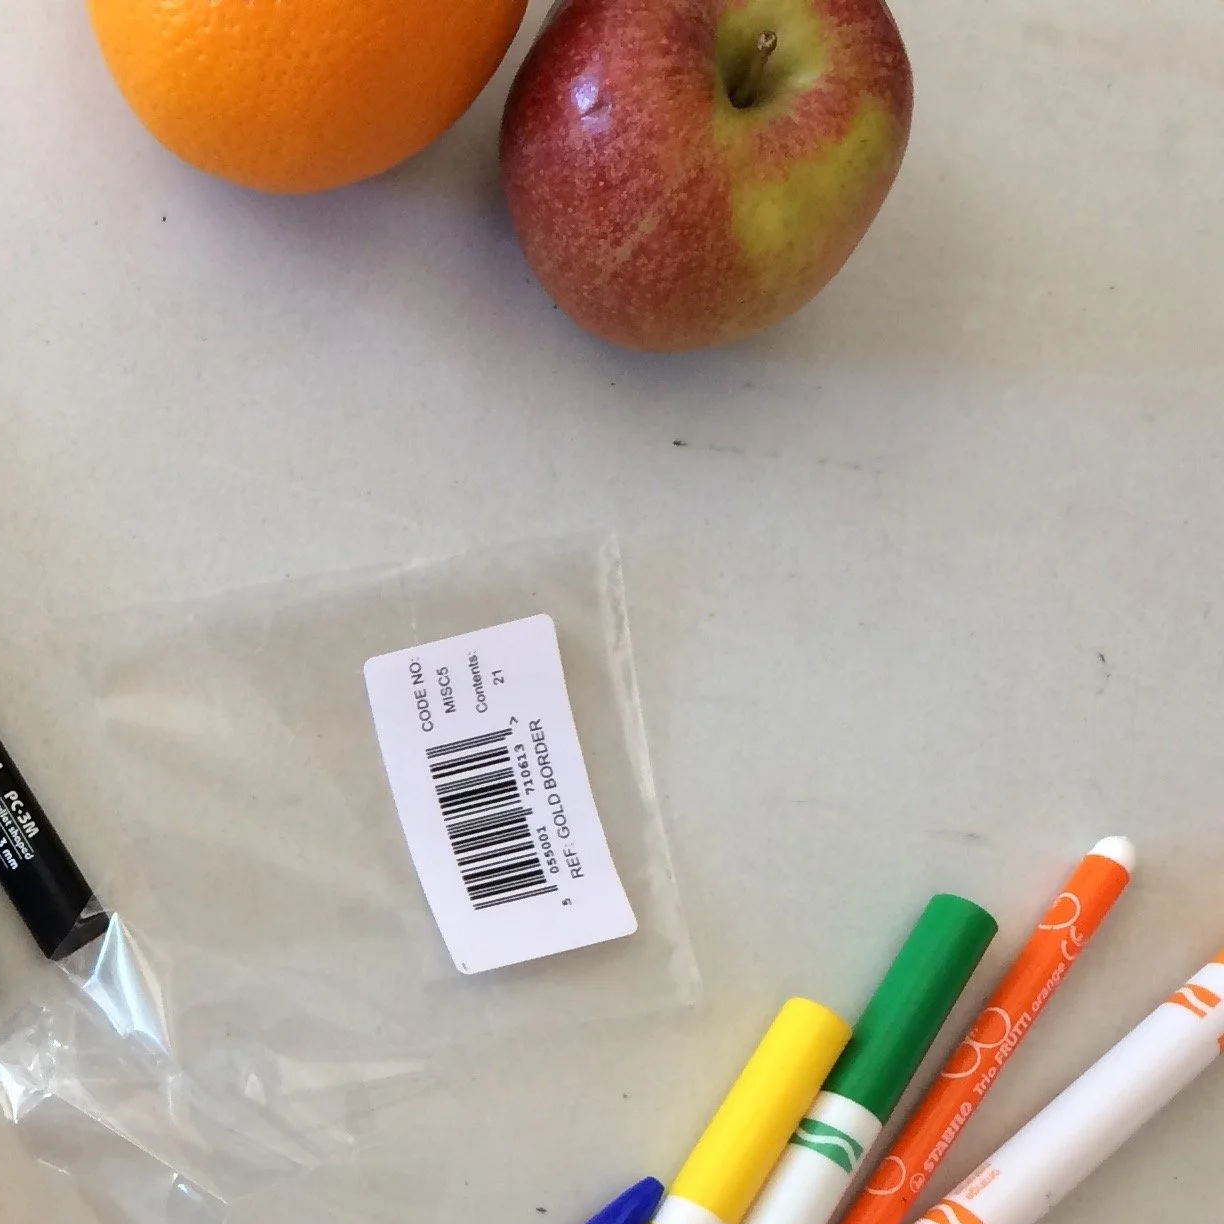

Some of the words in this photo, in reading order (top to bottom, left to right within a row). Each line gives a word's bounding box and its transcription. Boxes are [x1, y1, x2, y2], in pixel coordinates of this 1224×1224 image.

[404, 655, 426, 686] NO:
[434, 665, 460, 714] MISC5
[461, 649, 492, 714] Contents:
[490, 668, 506, 685] 21
[411, 687, 437, 733] CODE
[512, 741, 537, 795] 710613
[526, 717, 559, 790] BORDER
[546, 791, 572, 840] GOLD
[0, 847, 19, 870] mm
[535, 823, 560, 875] 055001
[561, 840, 584, 879] REF:
[560, 896, 572, 907] 5
[919, 1099, 976, 1174] STABILO
[971, 1063, 1000, 1098] Trio
[991, 1010, 1035, 1066] FRUTTI
[1027, 959, 1070, 1014] orange
